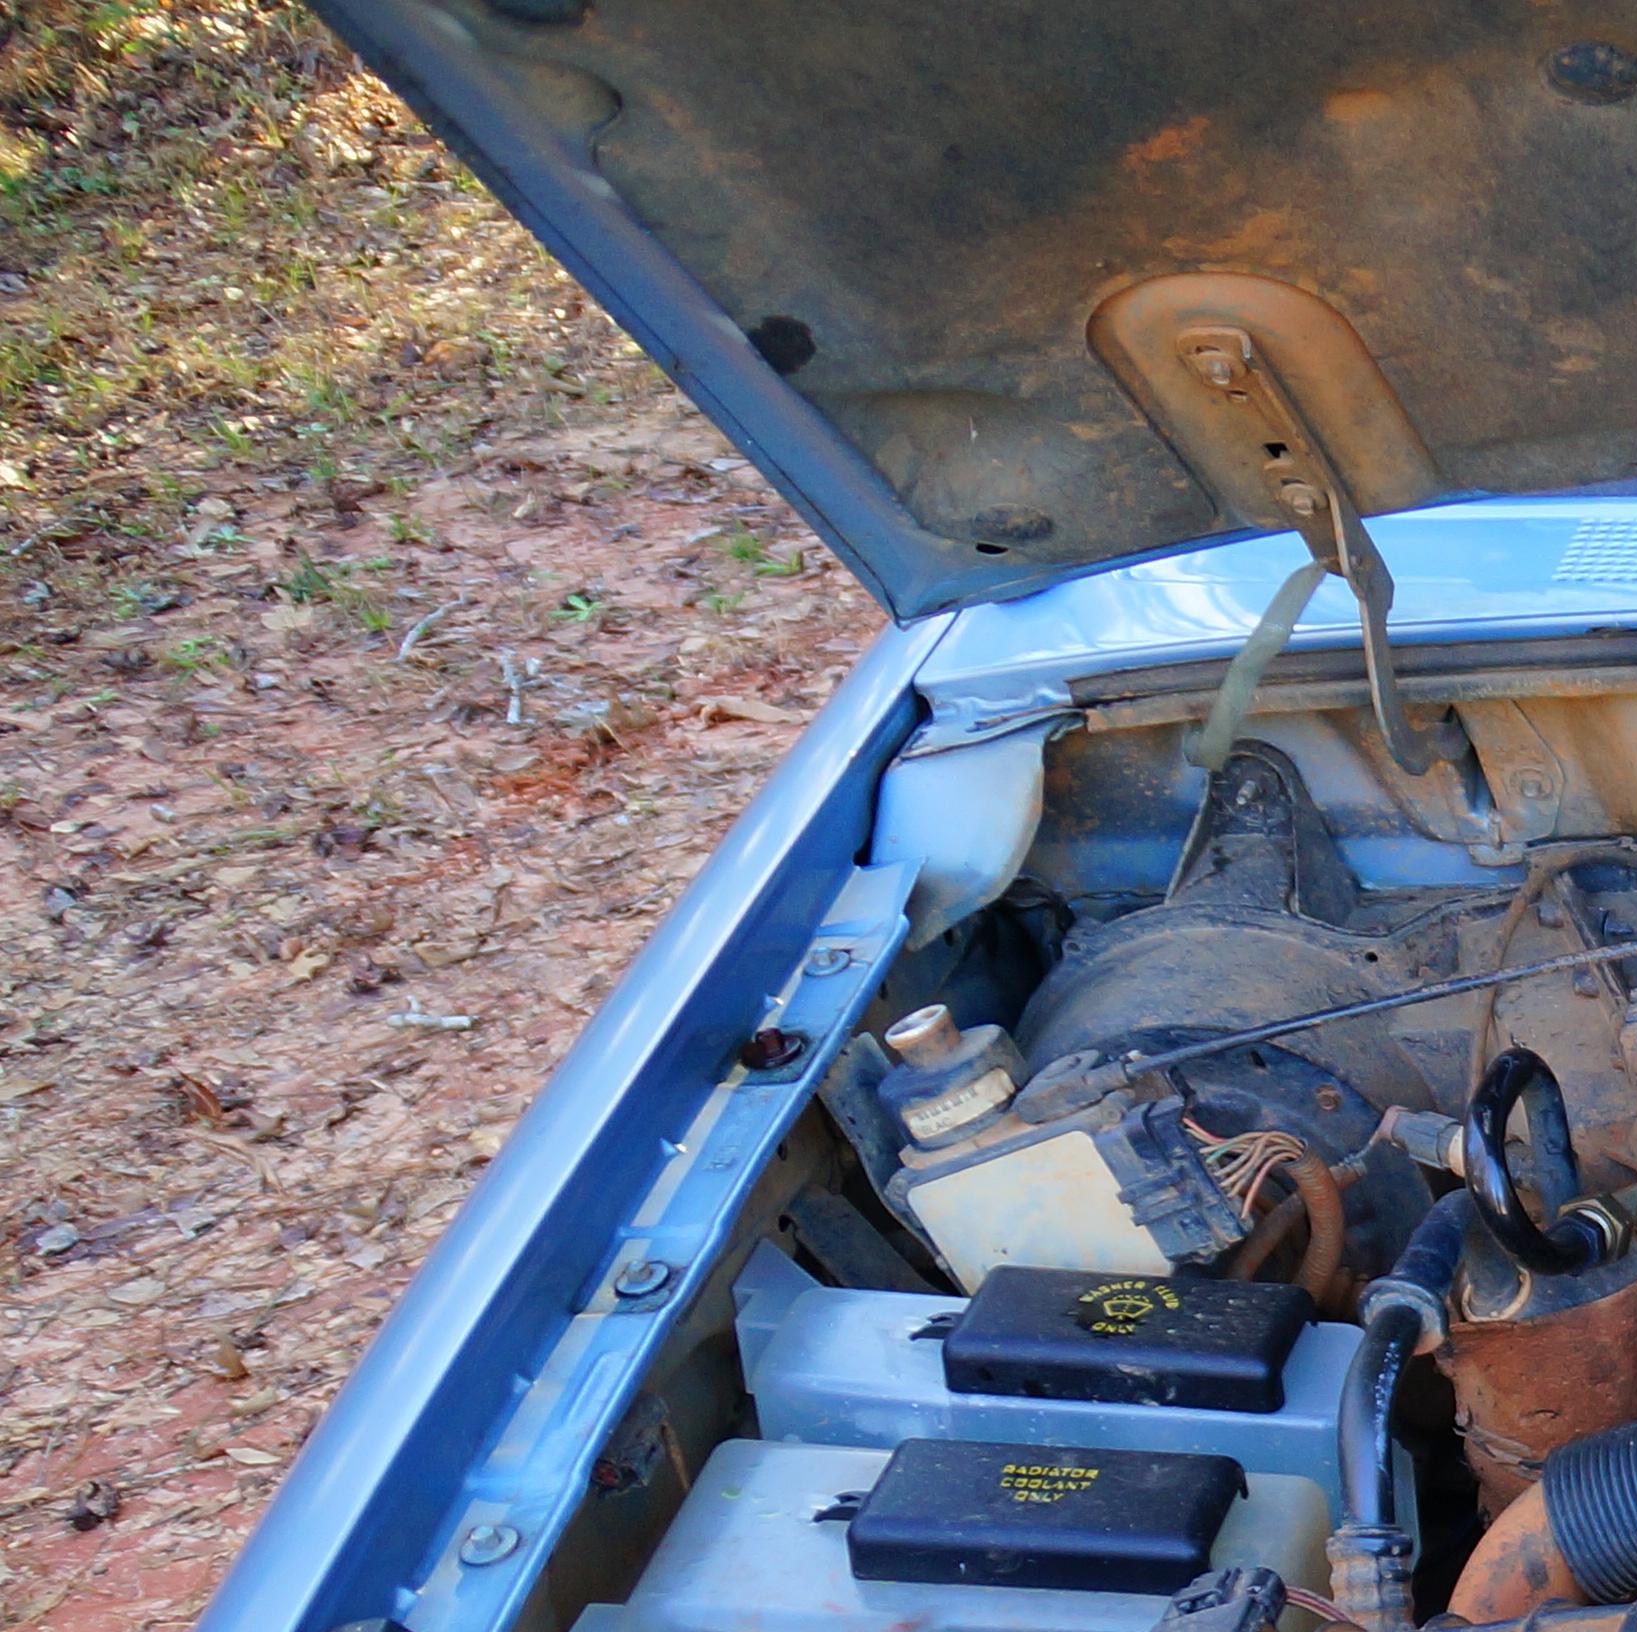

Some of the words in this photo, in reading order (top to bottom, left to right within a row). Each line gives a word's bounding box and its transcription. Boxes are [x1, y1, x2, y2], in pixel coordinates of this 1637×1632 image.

[1091, 1322, 1136, 1334] ONLY
[1002, 1464, 1100, 1479] RADIATOR
[1000, 1477, 1091, 1490] COOLANT
[1013, 1490, 1065, 1502] ONLY
